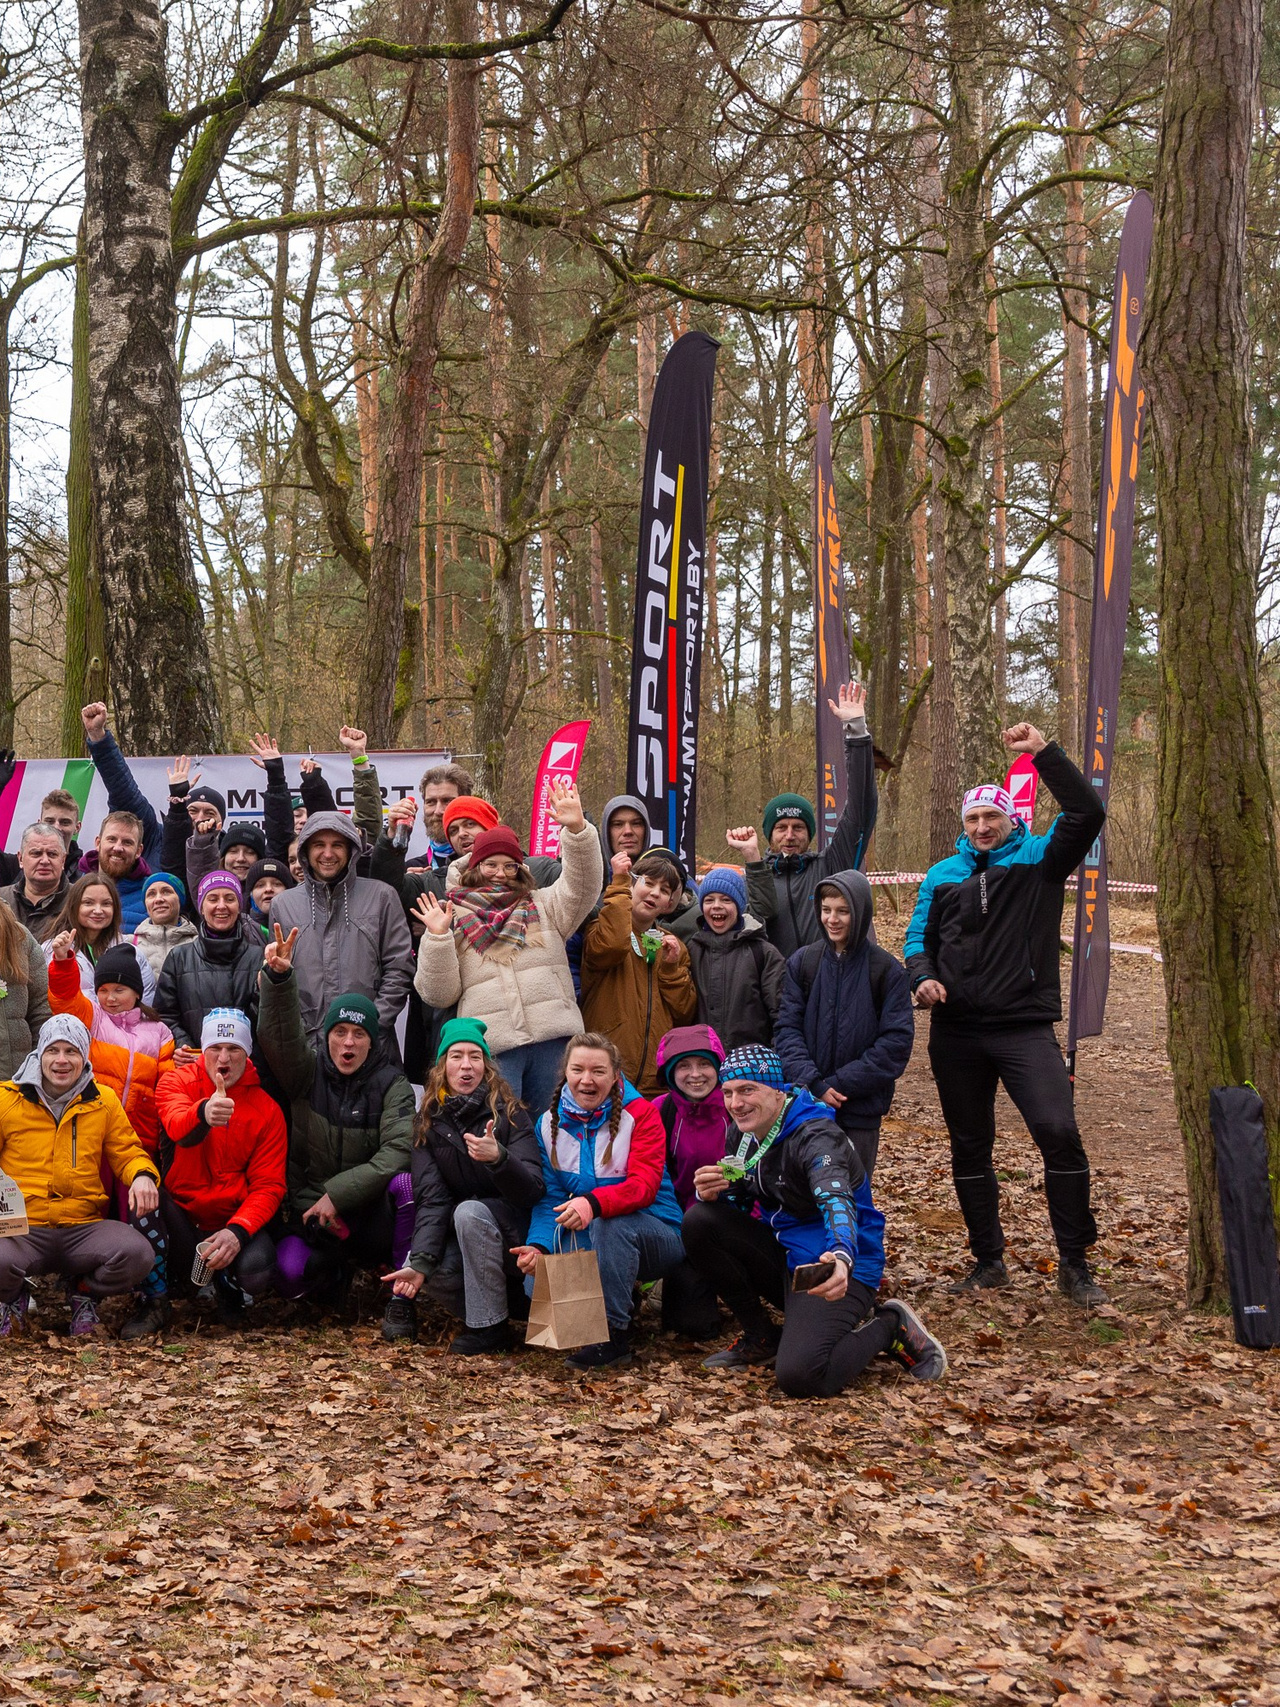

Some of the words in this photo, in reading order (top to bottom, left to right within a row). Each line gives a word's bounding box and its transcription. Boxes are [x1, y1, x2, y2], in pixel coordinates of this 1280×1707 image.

[980, 872, 988, 914] NORDSKI
[767, 1126, 779, 1144] CITY
[738, 1141, 749, 1157] CITY
[754, 1144, 767, 1161] TRAIL
